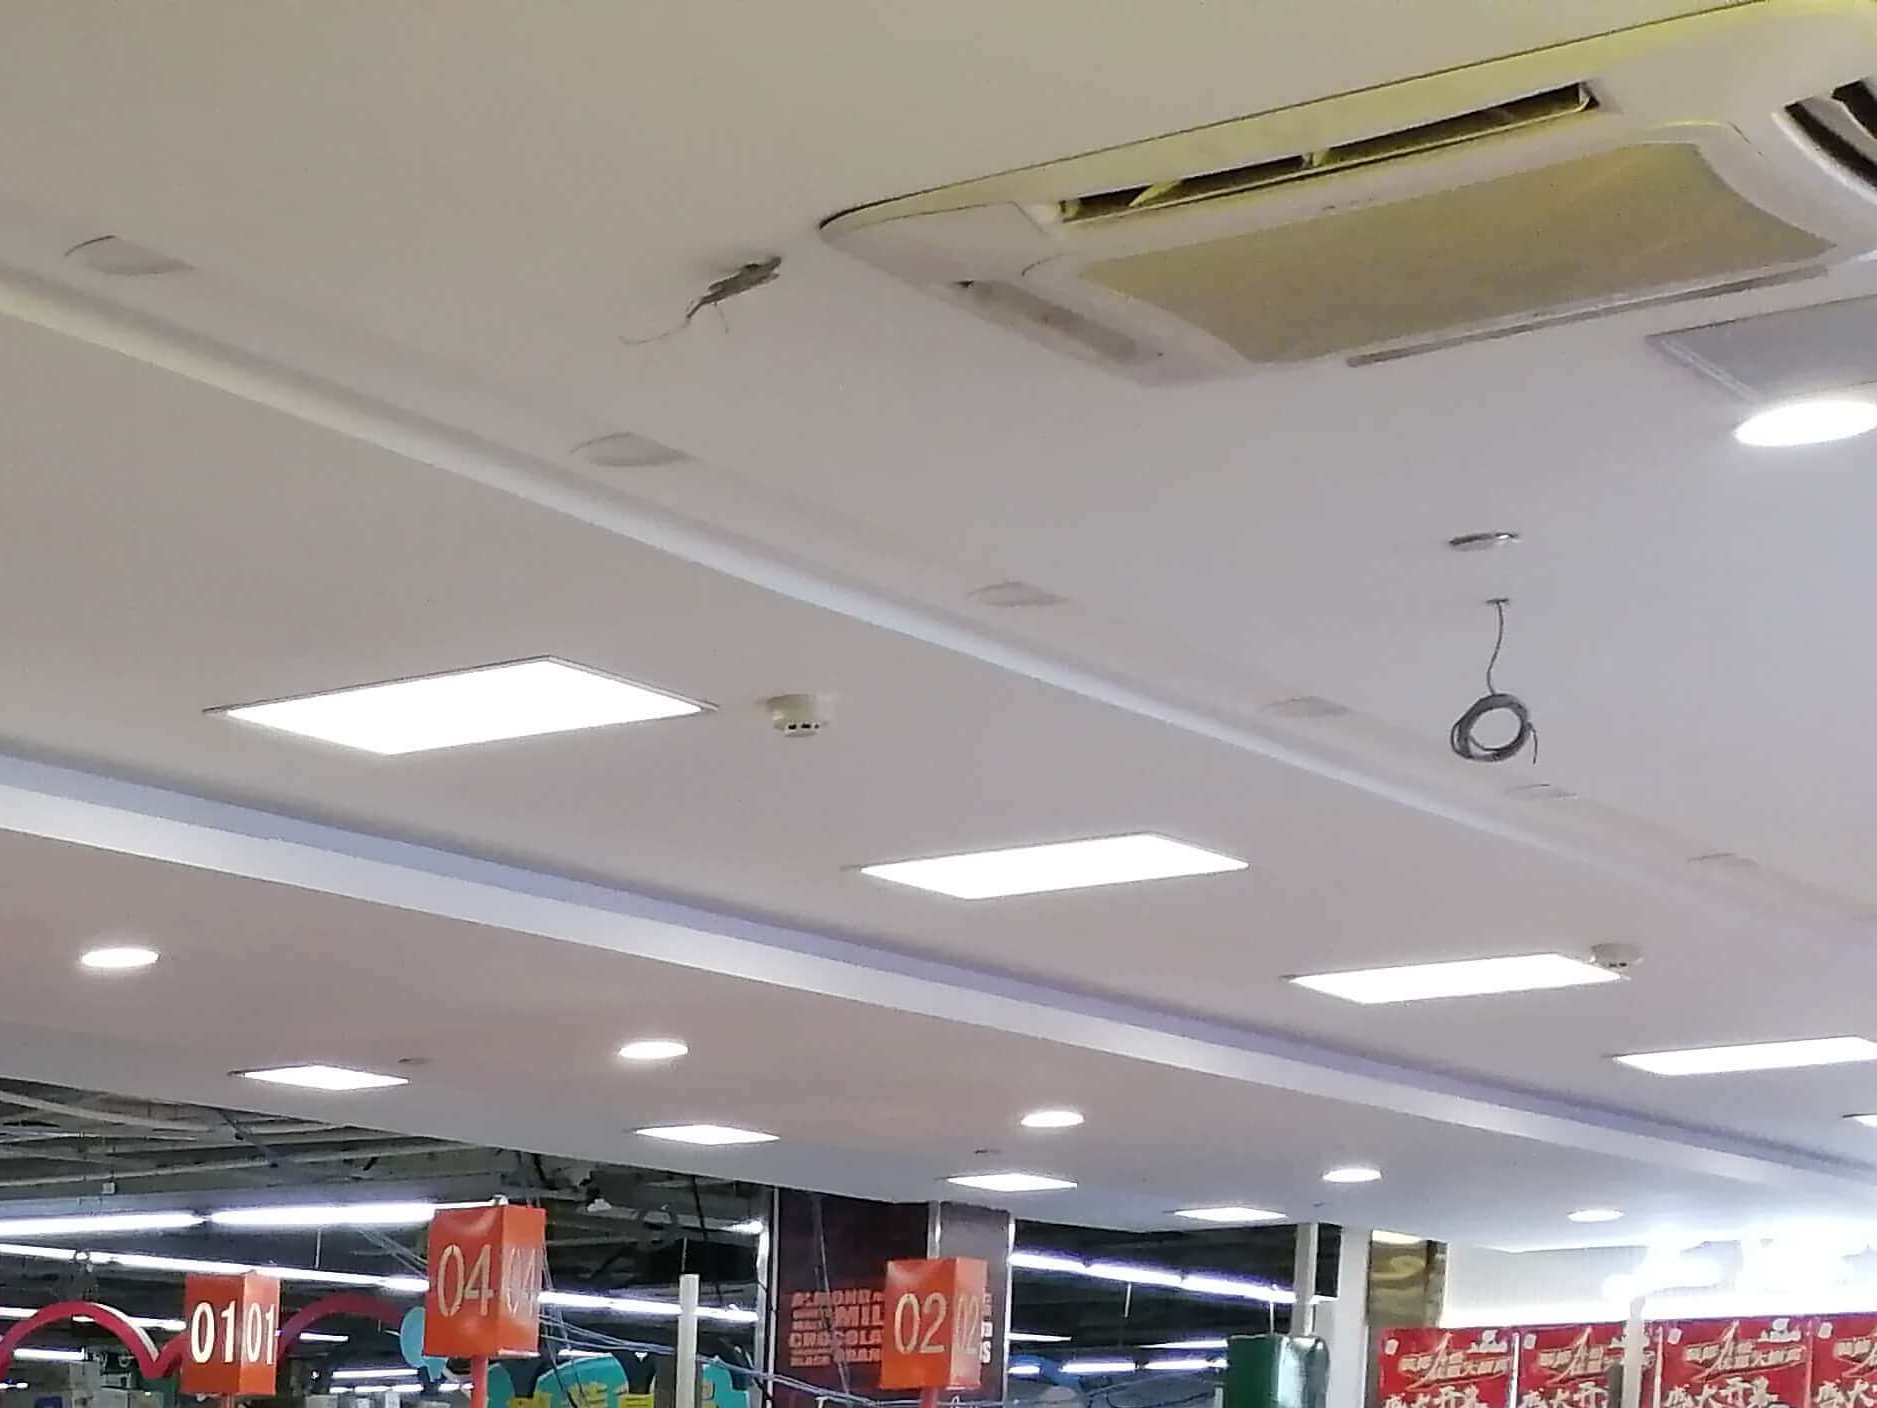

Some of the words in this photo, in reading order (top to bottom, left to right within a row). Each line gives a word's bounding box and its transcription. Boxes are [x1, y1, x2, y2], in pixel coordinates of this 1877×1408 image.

[437, 1243, 494, 1319] 04
[190, 1301, 236, 1364] 01
[246, 1302, 276, 1366] 01
[895, 1292, 946, 1354] 02
